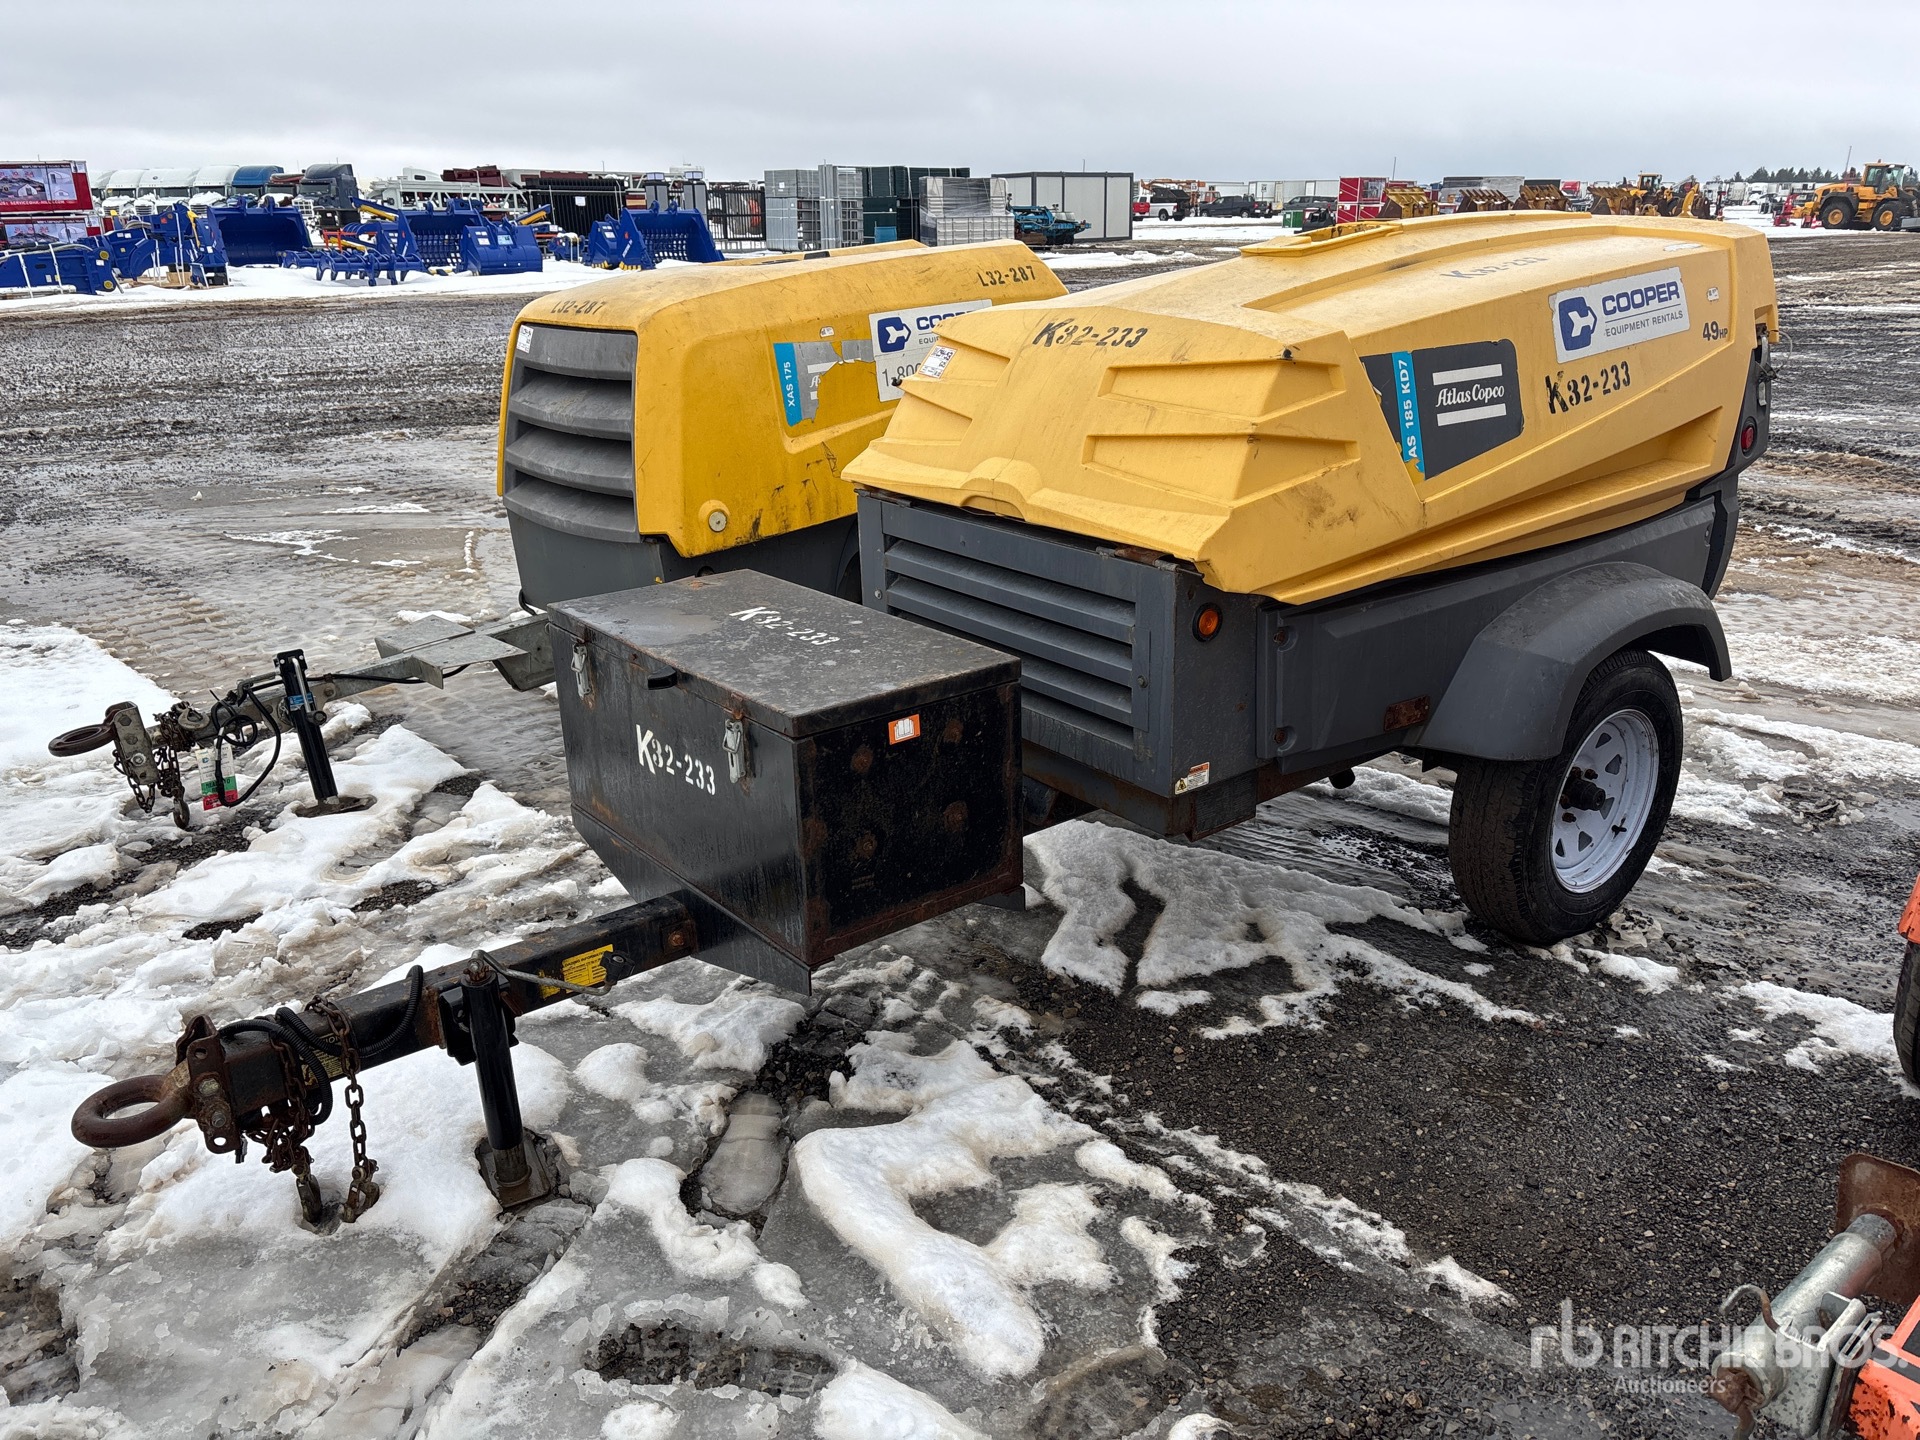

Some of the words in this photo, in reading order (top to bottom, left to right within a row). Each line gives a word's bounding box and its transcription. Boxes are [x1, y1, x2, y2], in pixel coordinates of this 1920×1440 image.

[976, 265, 1036, 287] L32-287
[550, 300, 605, 315] L32-287
[1601, 280, 1681, 316] COOPER
[1032, 317, 1149, 348] K32-233
[1605, 318, 1650, 337] EQUIPMENT
[1652, 310, 1684, 325] RENTALS
[783, 361, 792, 380] 175
[1398, 360, 1411, 394] KD7
[786, 383, 796, 407] XAS
[1545, 360, 1631, 414] K32-233
[1403, 399, 1414, 429] 185
[729, 606, 841, 646] K32-233
[635, 723, 716, 796] K32-233
